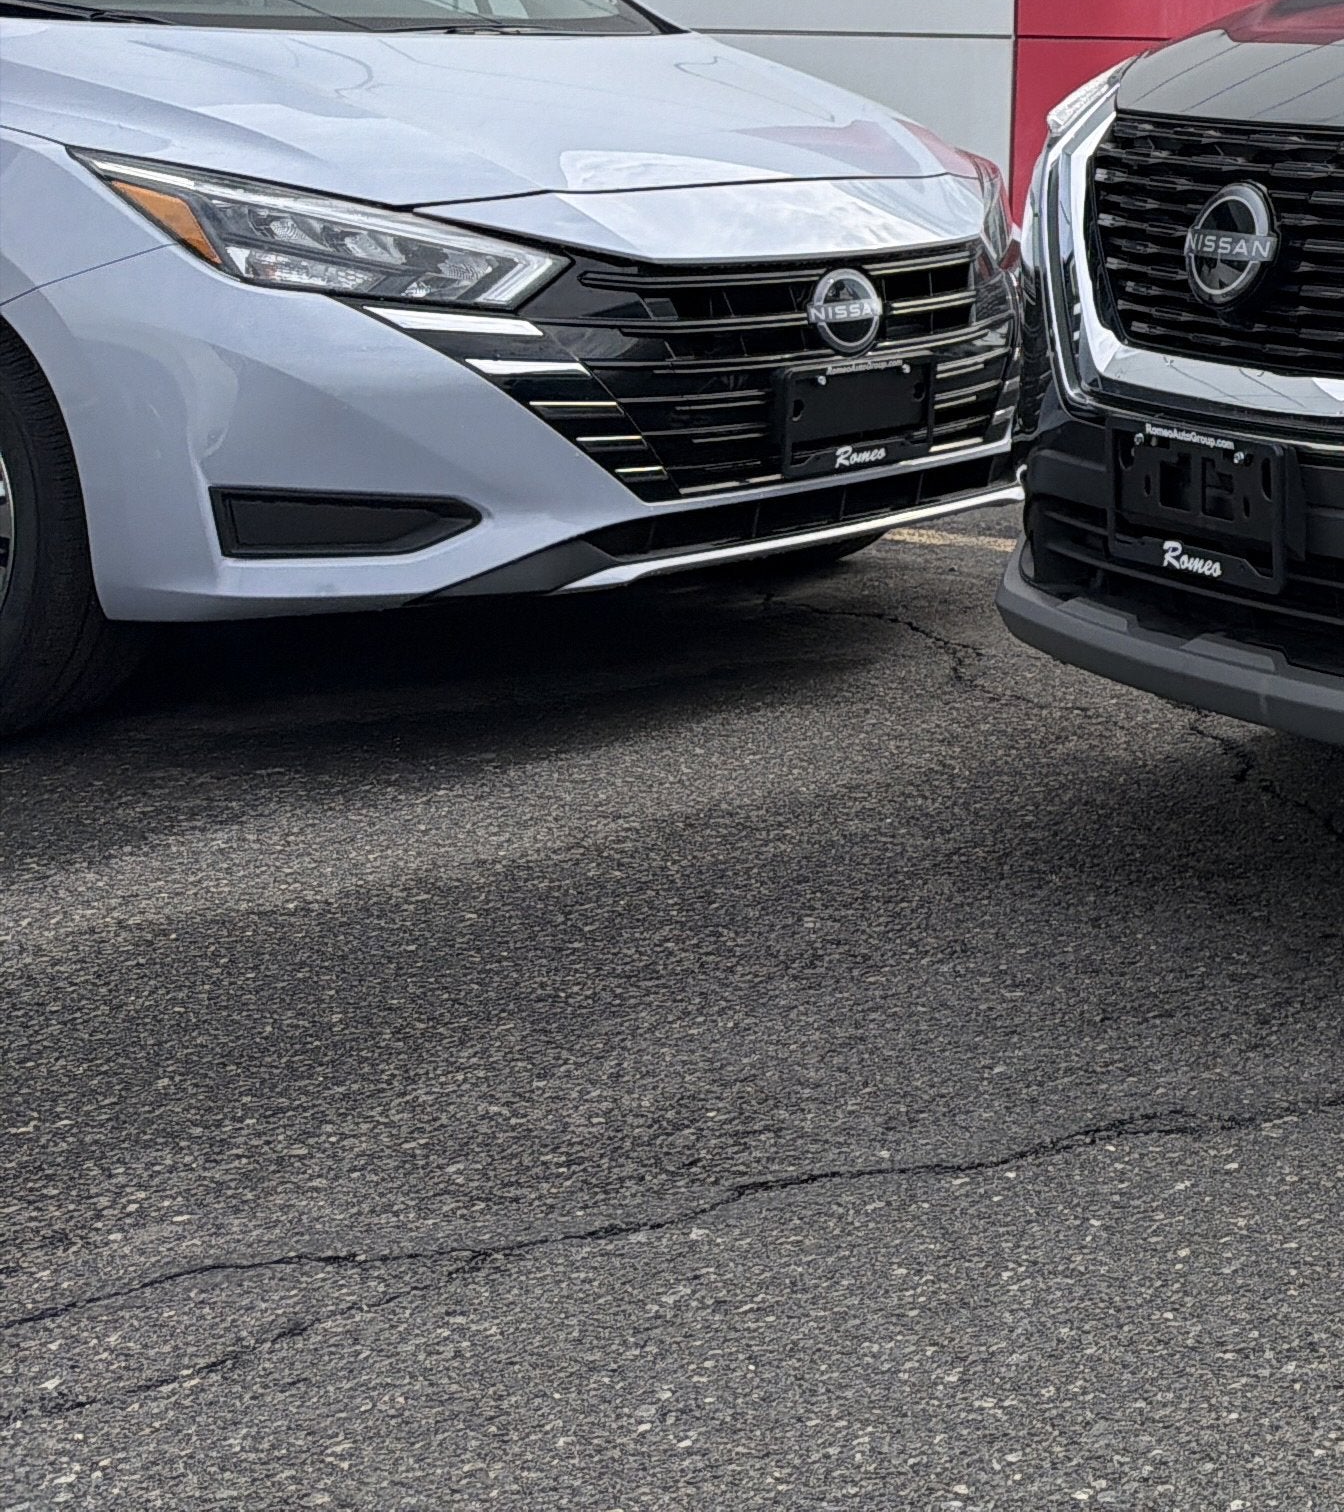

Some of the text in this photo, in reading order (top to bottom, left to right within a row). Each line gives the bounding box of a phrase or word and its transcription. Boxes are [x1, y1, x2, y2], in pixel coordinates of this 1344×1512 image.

[1184, 230, 1271, 258] NISSAN
[810, 301, 880, 321] NISSA
[1145, 422, 1235, 450] RomeoAutoGroup.com
[835, 445, 886, 469] Romeo
[1163, 540, 1222, 577] Romeo
